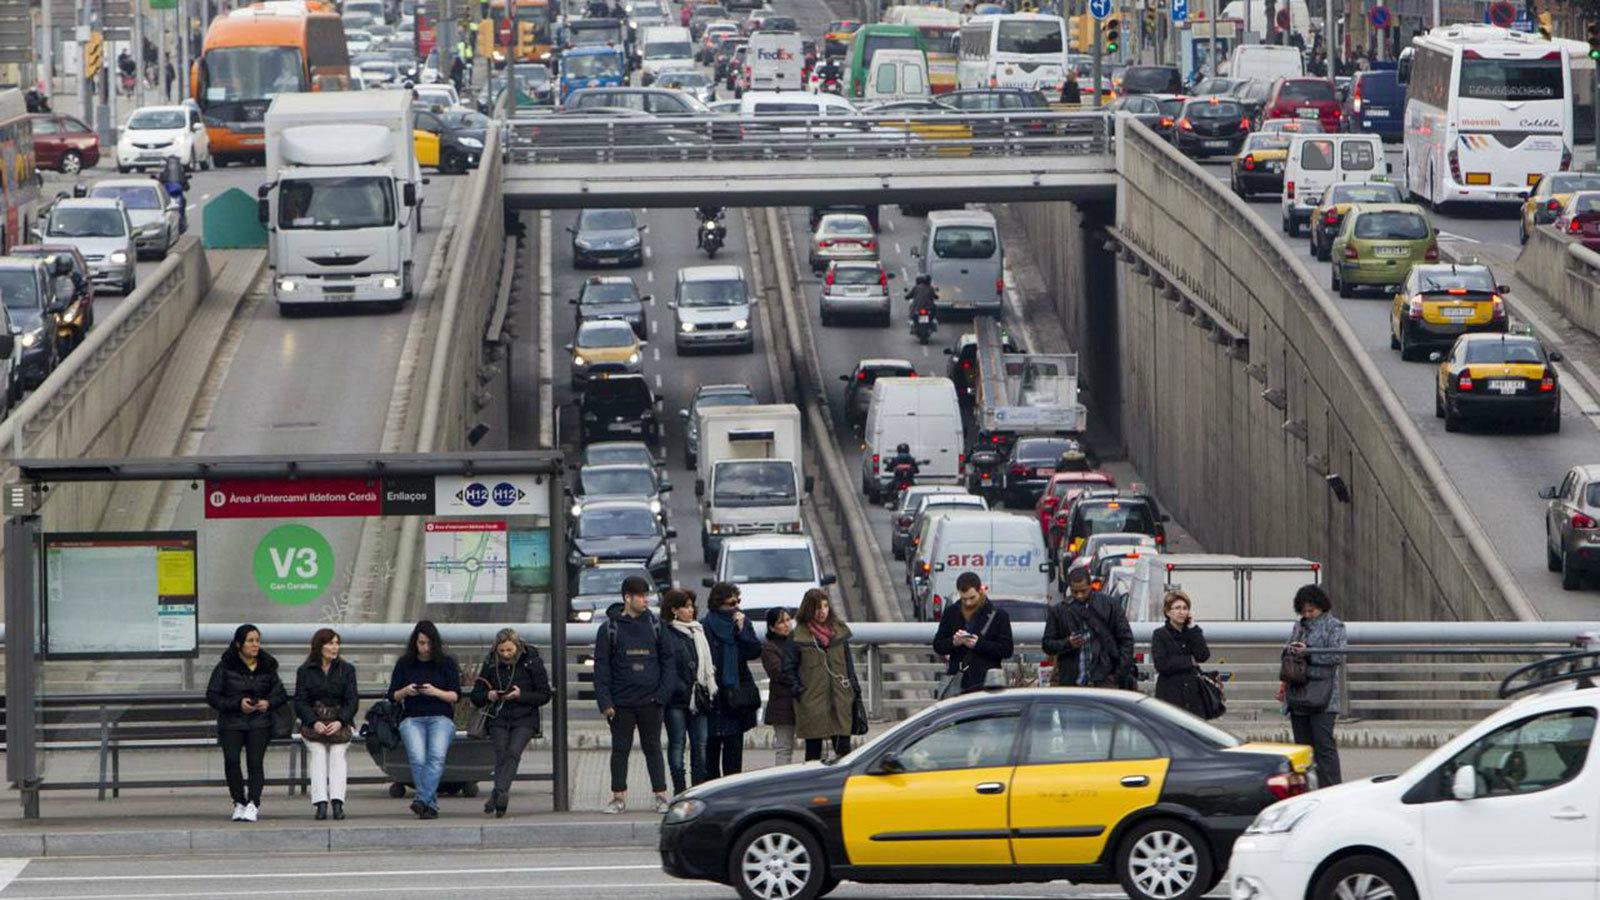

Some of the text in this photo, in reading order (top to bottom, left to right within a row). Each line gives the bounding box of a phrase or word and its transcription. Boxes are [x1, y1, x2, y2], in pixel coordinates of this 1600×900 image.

[757, 48, 794, 60] FedEx
[1461, 118, 1501, 127] moventis
[230, 492, 252, 503] Àrea
[253, 492, 307, 503] d'intercanvi
[309, 493, 347, 502] Ildefons
[348, 491, 377, 501] Cerdà
[386, 491, 427, 504] Enllaços
[466, 489, 488, 500] H12
[493, 489, 517, 500] H12
[269, 547, 319, 578] V3
